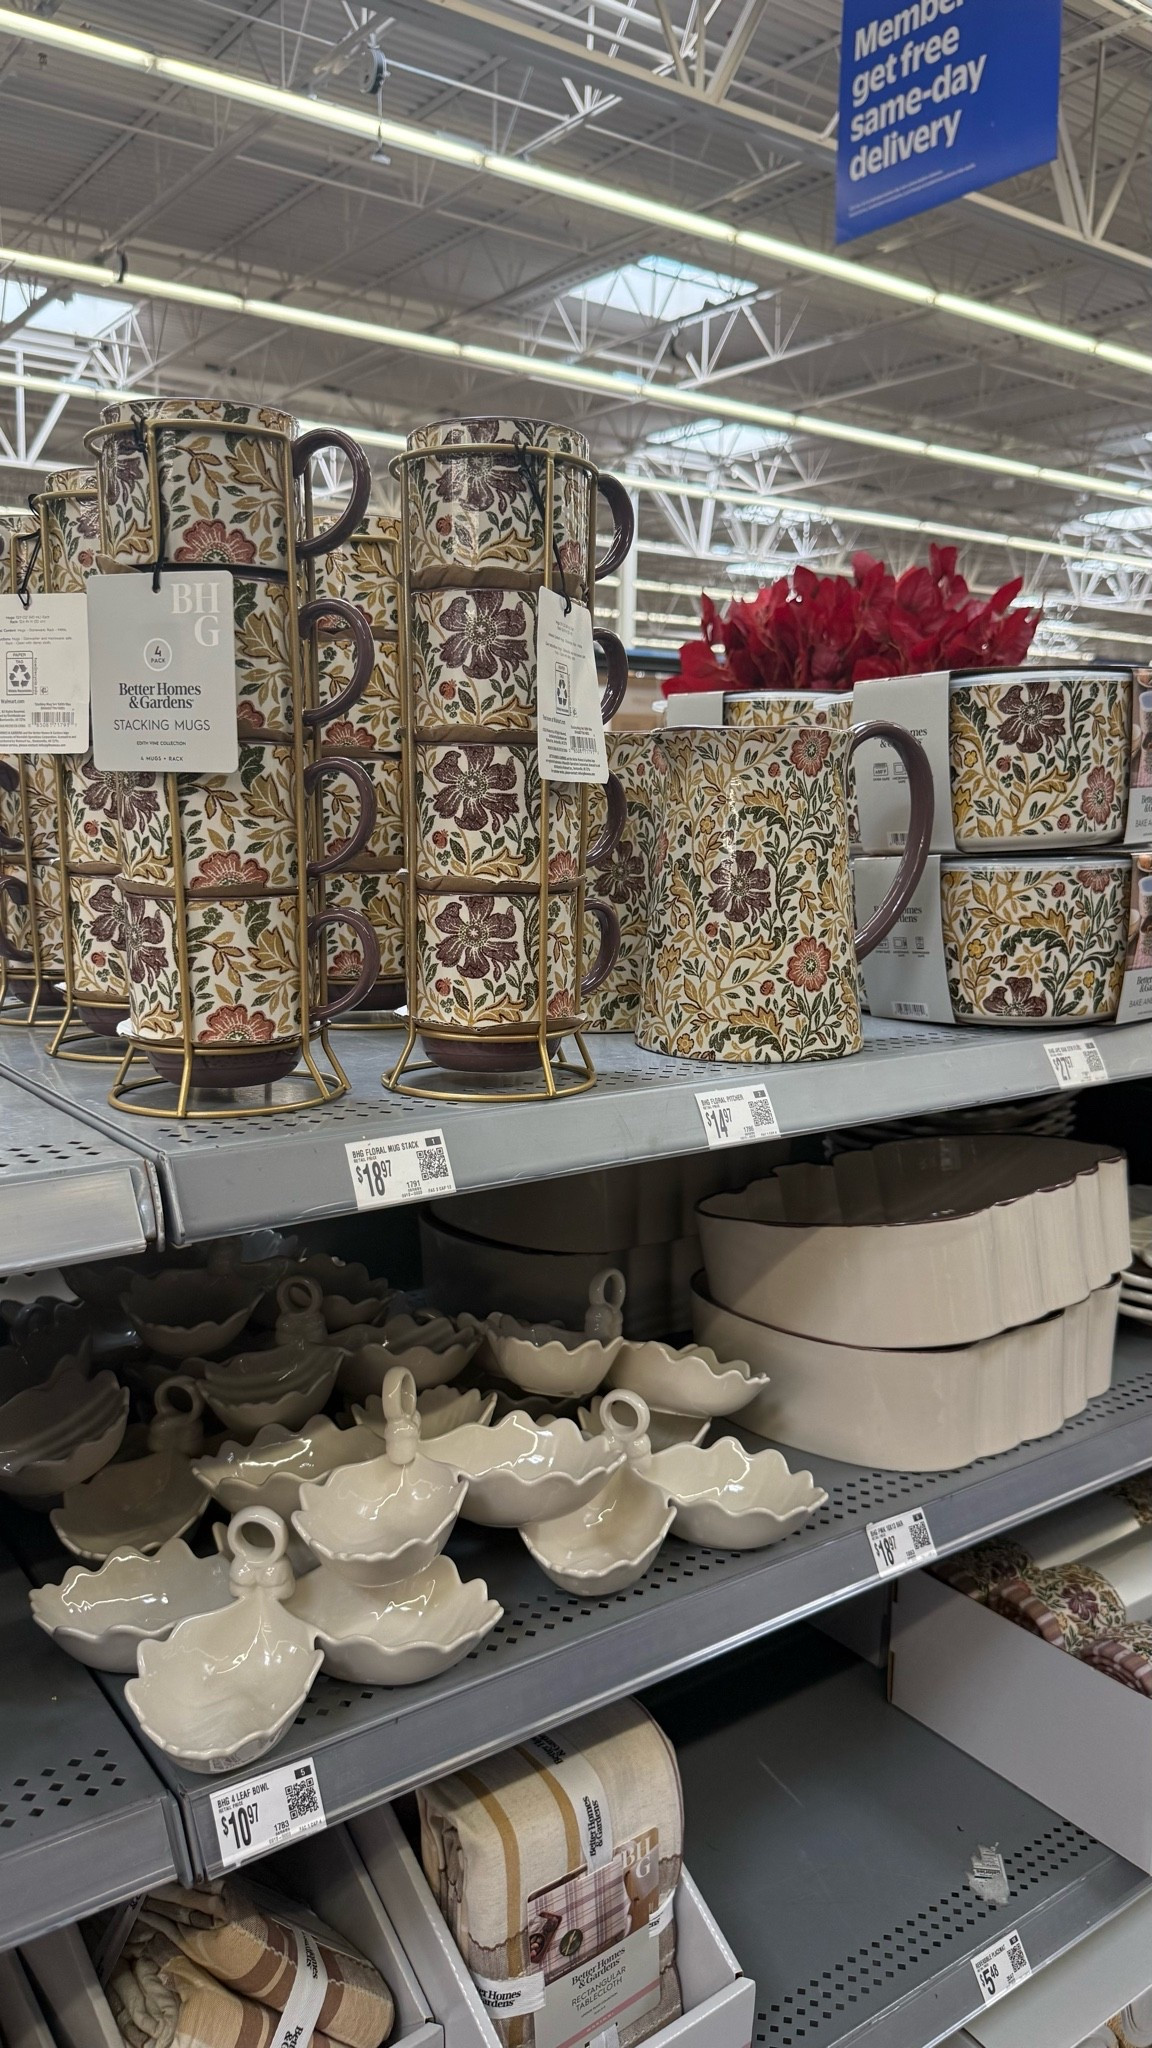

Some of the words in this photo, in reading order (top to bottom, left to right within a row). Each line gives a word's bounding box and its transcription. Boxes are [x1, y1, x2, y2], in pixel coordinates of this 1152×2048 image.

[851, 53, 897, 108] get
[900, 26, 960, 78] free
[850, 54, 987, 142] same-day
[849, 109, 962, 182] delivery
[170, 582, 221, 614] BH
[194, 616, 220, 647] G
[154, 645, 162, 657] 4
[119, 683, 156, 696] Better
[157, 683, 201, 696] Homes
[114, 719, 169, 731] STACKING
[174, 719, 211, 731] MUGS
[352, 1150, 364, 1159] BHG
[365, 1147, 387, 1156] FLORAL
[388, 1144, 400, 1153] MUG
[401, 1141, 419, 1150] STACK
[406, 1180, 421, 1188] 1791
[217, 1797, 230, 1809] BHG
[236, 1789, 251, 1802] LEAF
[252, 1782, 270, 1796] BOWL
[583, 1796, 596, 1832] Homes
[589, 1831, 597, 1857] Better
[571, 1965, 597, 1986] Better
[597, 1947, 626, 1970] Homes
[488, 1990, 521, 2001] Homes
[571, 1966, 626, 2007] RECTANGULAR
[576, 1976, 623, 2012] TABLECLOTH
